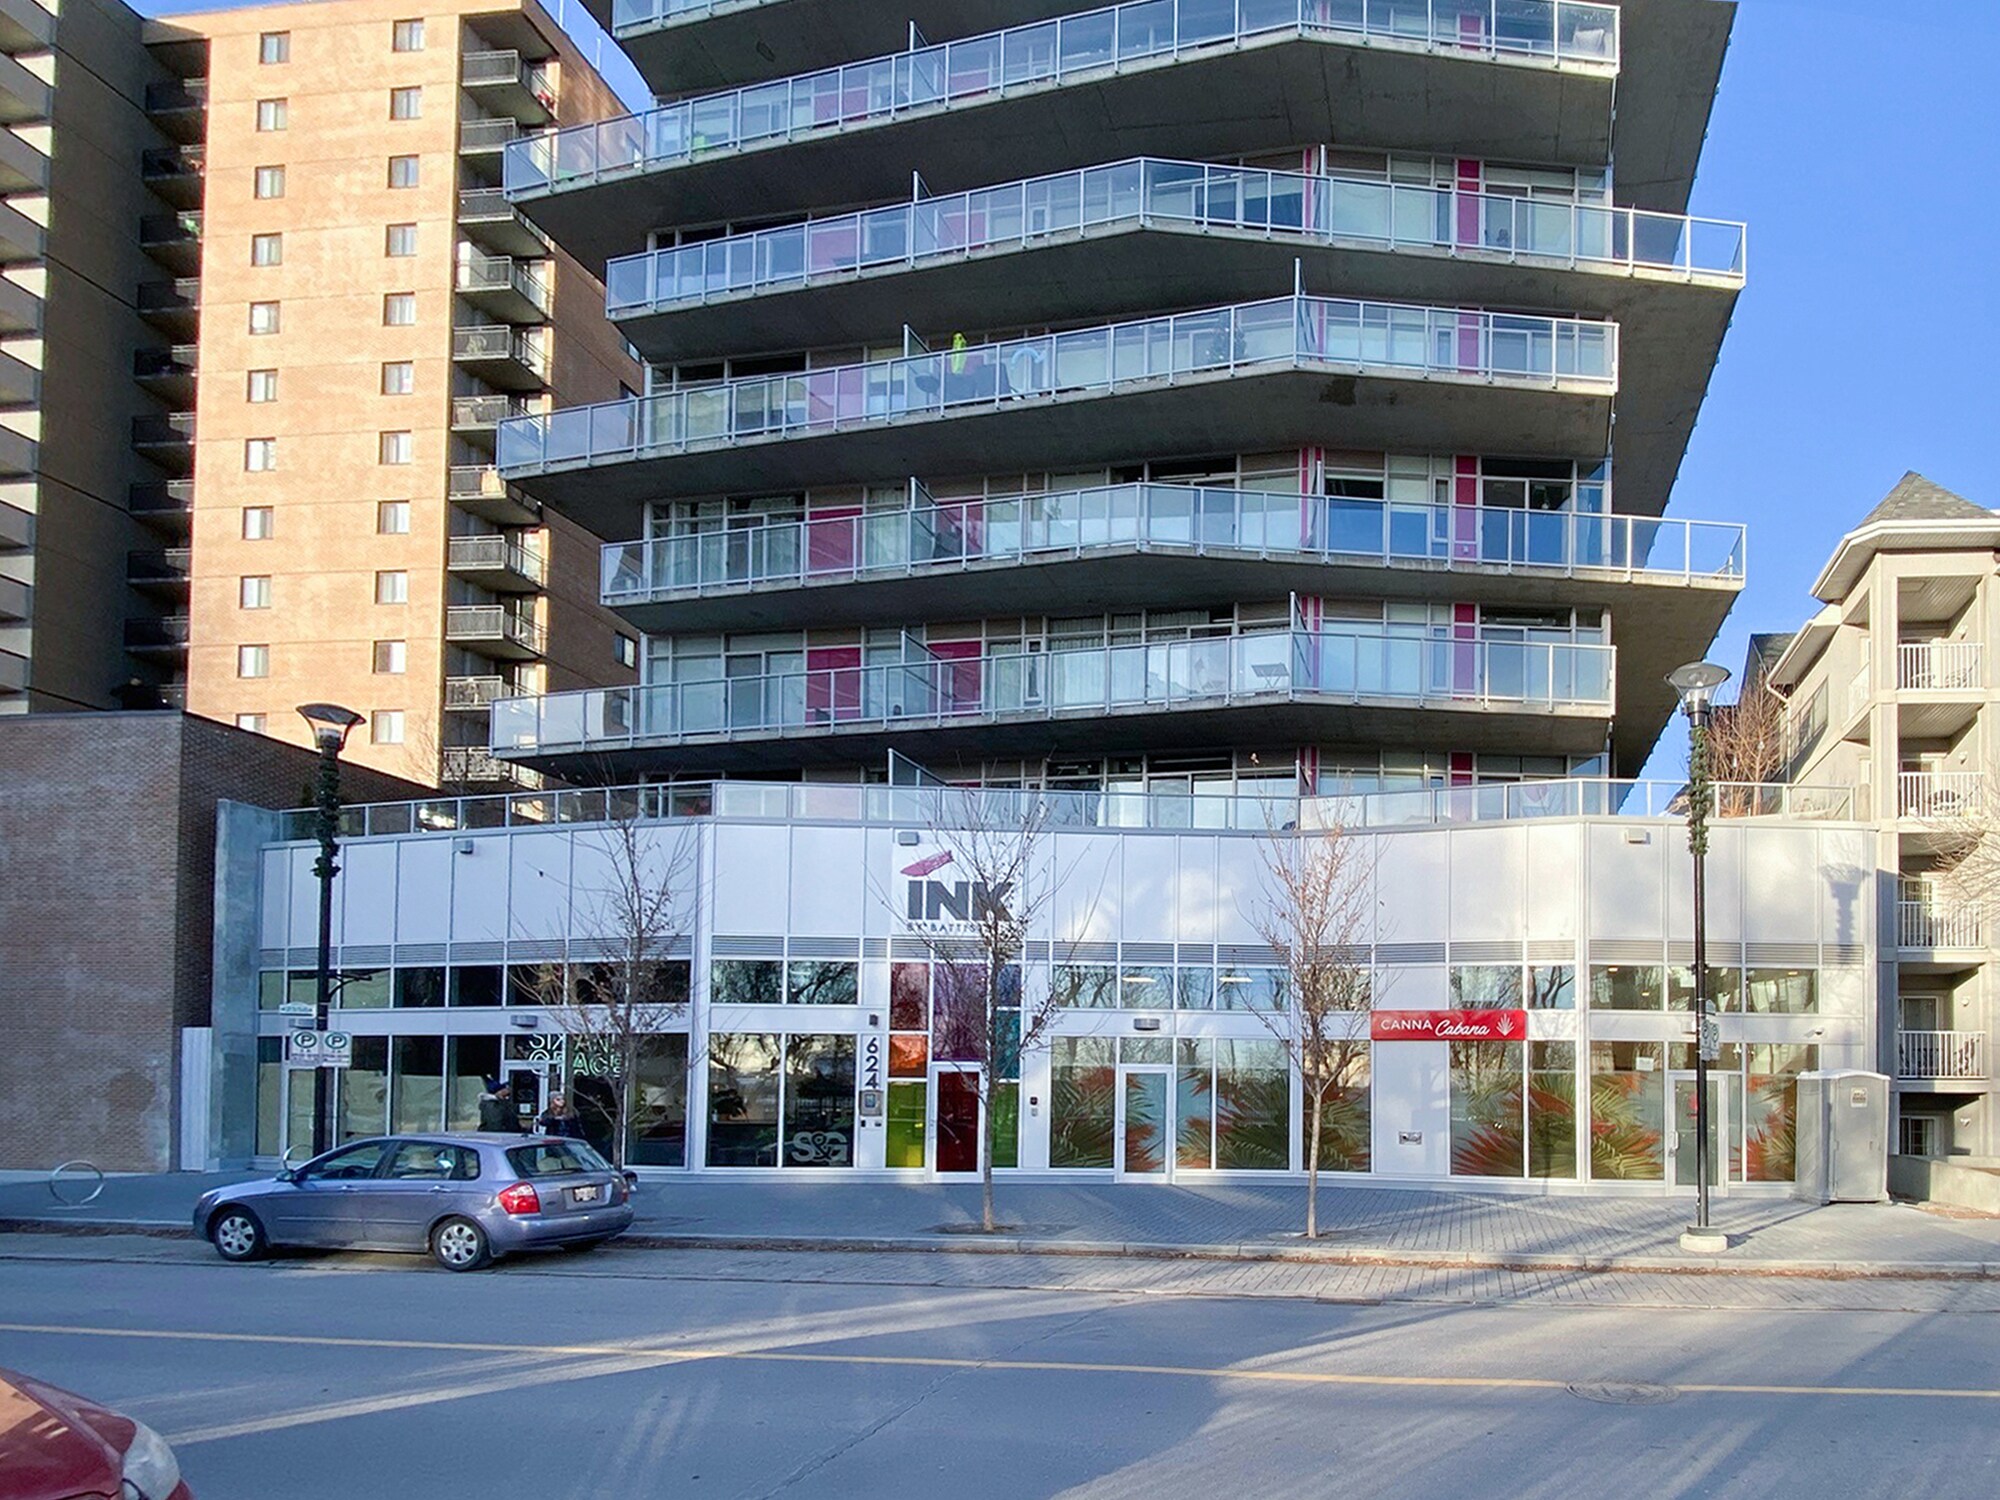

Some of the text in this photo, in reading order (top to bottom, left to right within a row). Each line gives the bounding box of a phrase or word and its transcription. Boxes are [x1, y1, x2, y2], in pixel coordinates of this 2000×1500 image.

[908, 880, 1014, 920] INK
[1380, 1019, 1490, 1037] CANNA Cabana
[864, 1036, 879, 1090] 624
